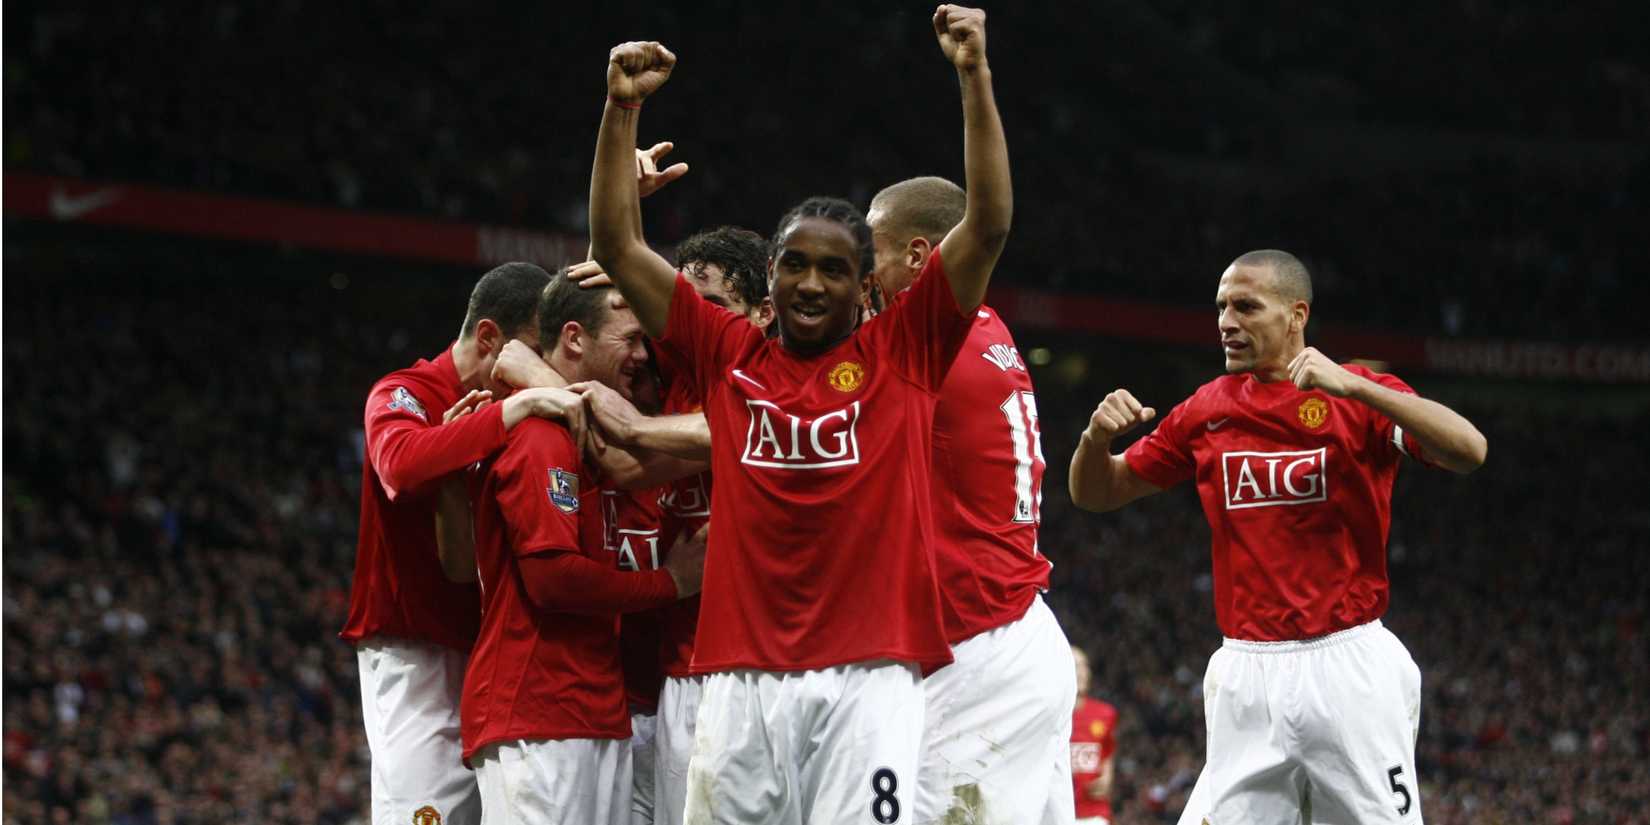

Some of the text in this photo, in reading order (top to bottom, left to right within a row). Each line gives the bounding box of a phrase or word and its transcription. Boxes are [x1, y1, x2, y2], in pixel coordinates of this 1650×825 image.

[751, 408, 849, 459] AIG
[1232, 456, 1319, 501] AIG
[617, 535, 659, 571] AI
[871, 767, 901, 825] 8
[1388, 765, 1411, 816] 5
